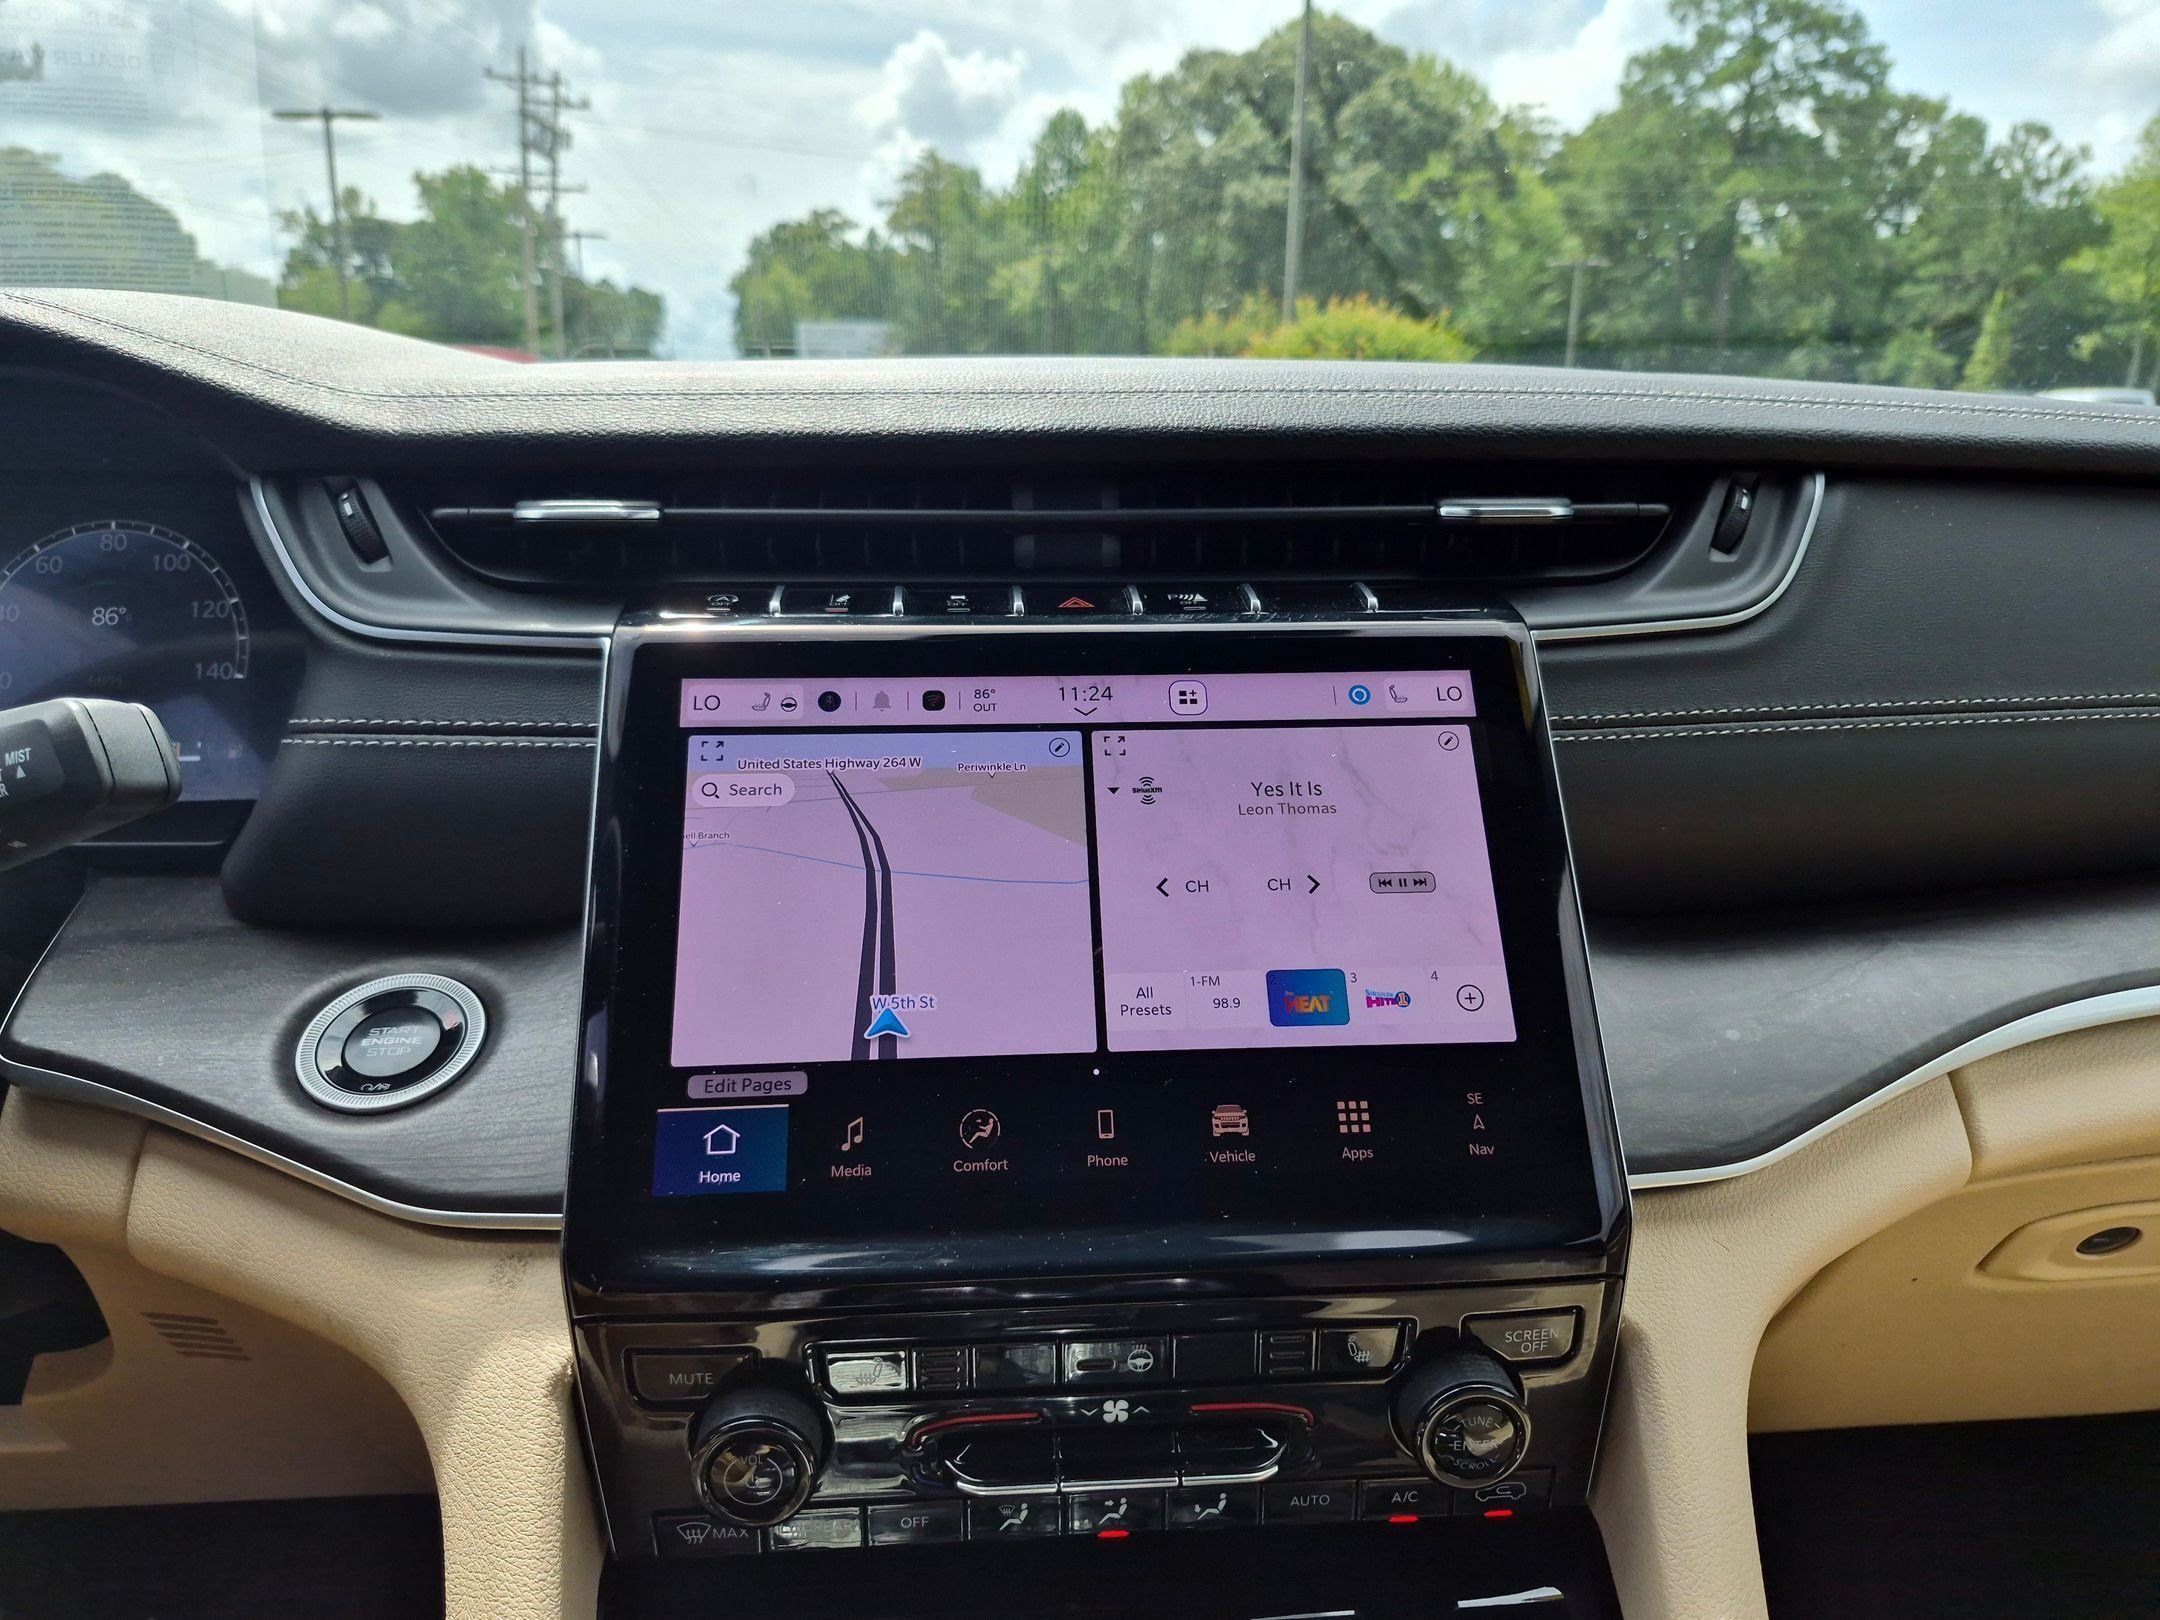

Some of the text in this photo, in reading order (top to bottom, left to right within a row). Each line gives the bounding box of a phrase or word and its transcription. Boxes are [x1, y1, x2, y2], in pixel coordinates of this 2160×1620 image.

[102, 533, 128, 551] 80
[35, 555, 63, 574] 60
[151, 552, 191, 572] 100
[191, 601, 231, 619] 120
[194, 663, 235, 682] 140
[1058, 686, 1114, 703] 11:24
[1436, 686, 1463, 702] LO
[693, 694, 722, 711] LO
[973, 703, 998, 713] OUT
[5, 748, 32, 766] MIST
[737, 757, 922, 772] United States Highway 264 W
[957, 761, 1027, 772] Periwinkle Ln
[729, 783, 783, 797] Search
[1251, 781, 1323, 797] Yes It Is
[1238, 802, 1337, 816] Leon Thomas
[698, 831, 730, 840] Branch
[1185, 880, 1209, 893] CH
[1267, 879, 1291, 891] CH
[1190, 976, 1221, 987] 1-FM
[1350, 972, 1358, 983] 3
[1430, 970, 1439, 981] 4
[1136, 987, 1154, 1000] All
[872, 996, 935, 1009] W 5th St
[1213, 998, 1241, 1009] 98.9
[1284, 994, 1331, 1013] HEAT
[1120, 1004, 1172, 1017] Presets
[369, 1027, 419, 1036] START
[361, 1037, 423, 1046] ENGINE
[367, 1047, 412, 1056] STOP
[704, 1077, 792, 1094] Edit Pages
[1467, 1092, 1482, 1104] SE
[1210, 1149, 1256, 1163] Vehicle
[1342, 1146, 1374, 1161] Apps
[1469, 1143, 1494, 1156] Nav
[953, 1159, 1008, 1173] Comfort
[1087, 1153, 1128, 1167] Phone
[700, 1170, 741, 1183] Home
[831, 1164, 872, 1178] Media
[1504, 1328, 1559, 1342] SCREEN
[1521, 1341, 1548, 1353] OFF
[669, 1372, 713, 1385] MUTE
[1460, 1416, 1493, 1429] TUNE
[1452, 1440, 1500, 1452] ENTER
[741, 1454, 763, 1464] VOL
[1453, 1455, 1499, 1472] SCROLL
[1290, 1494, 1330, 1507] AUTO
[1391, 1491, 1418, 1503] A/C
[900, 1515, 929, 1528] OFF
[712, 1527, 749, 1539] MAX
